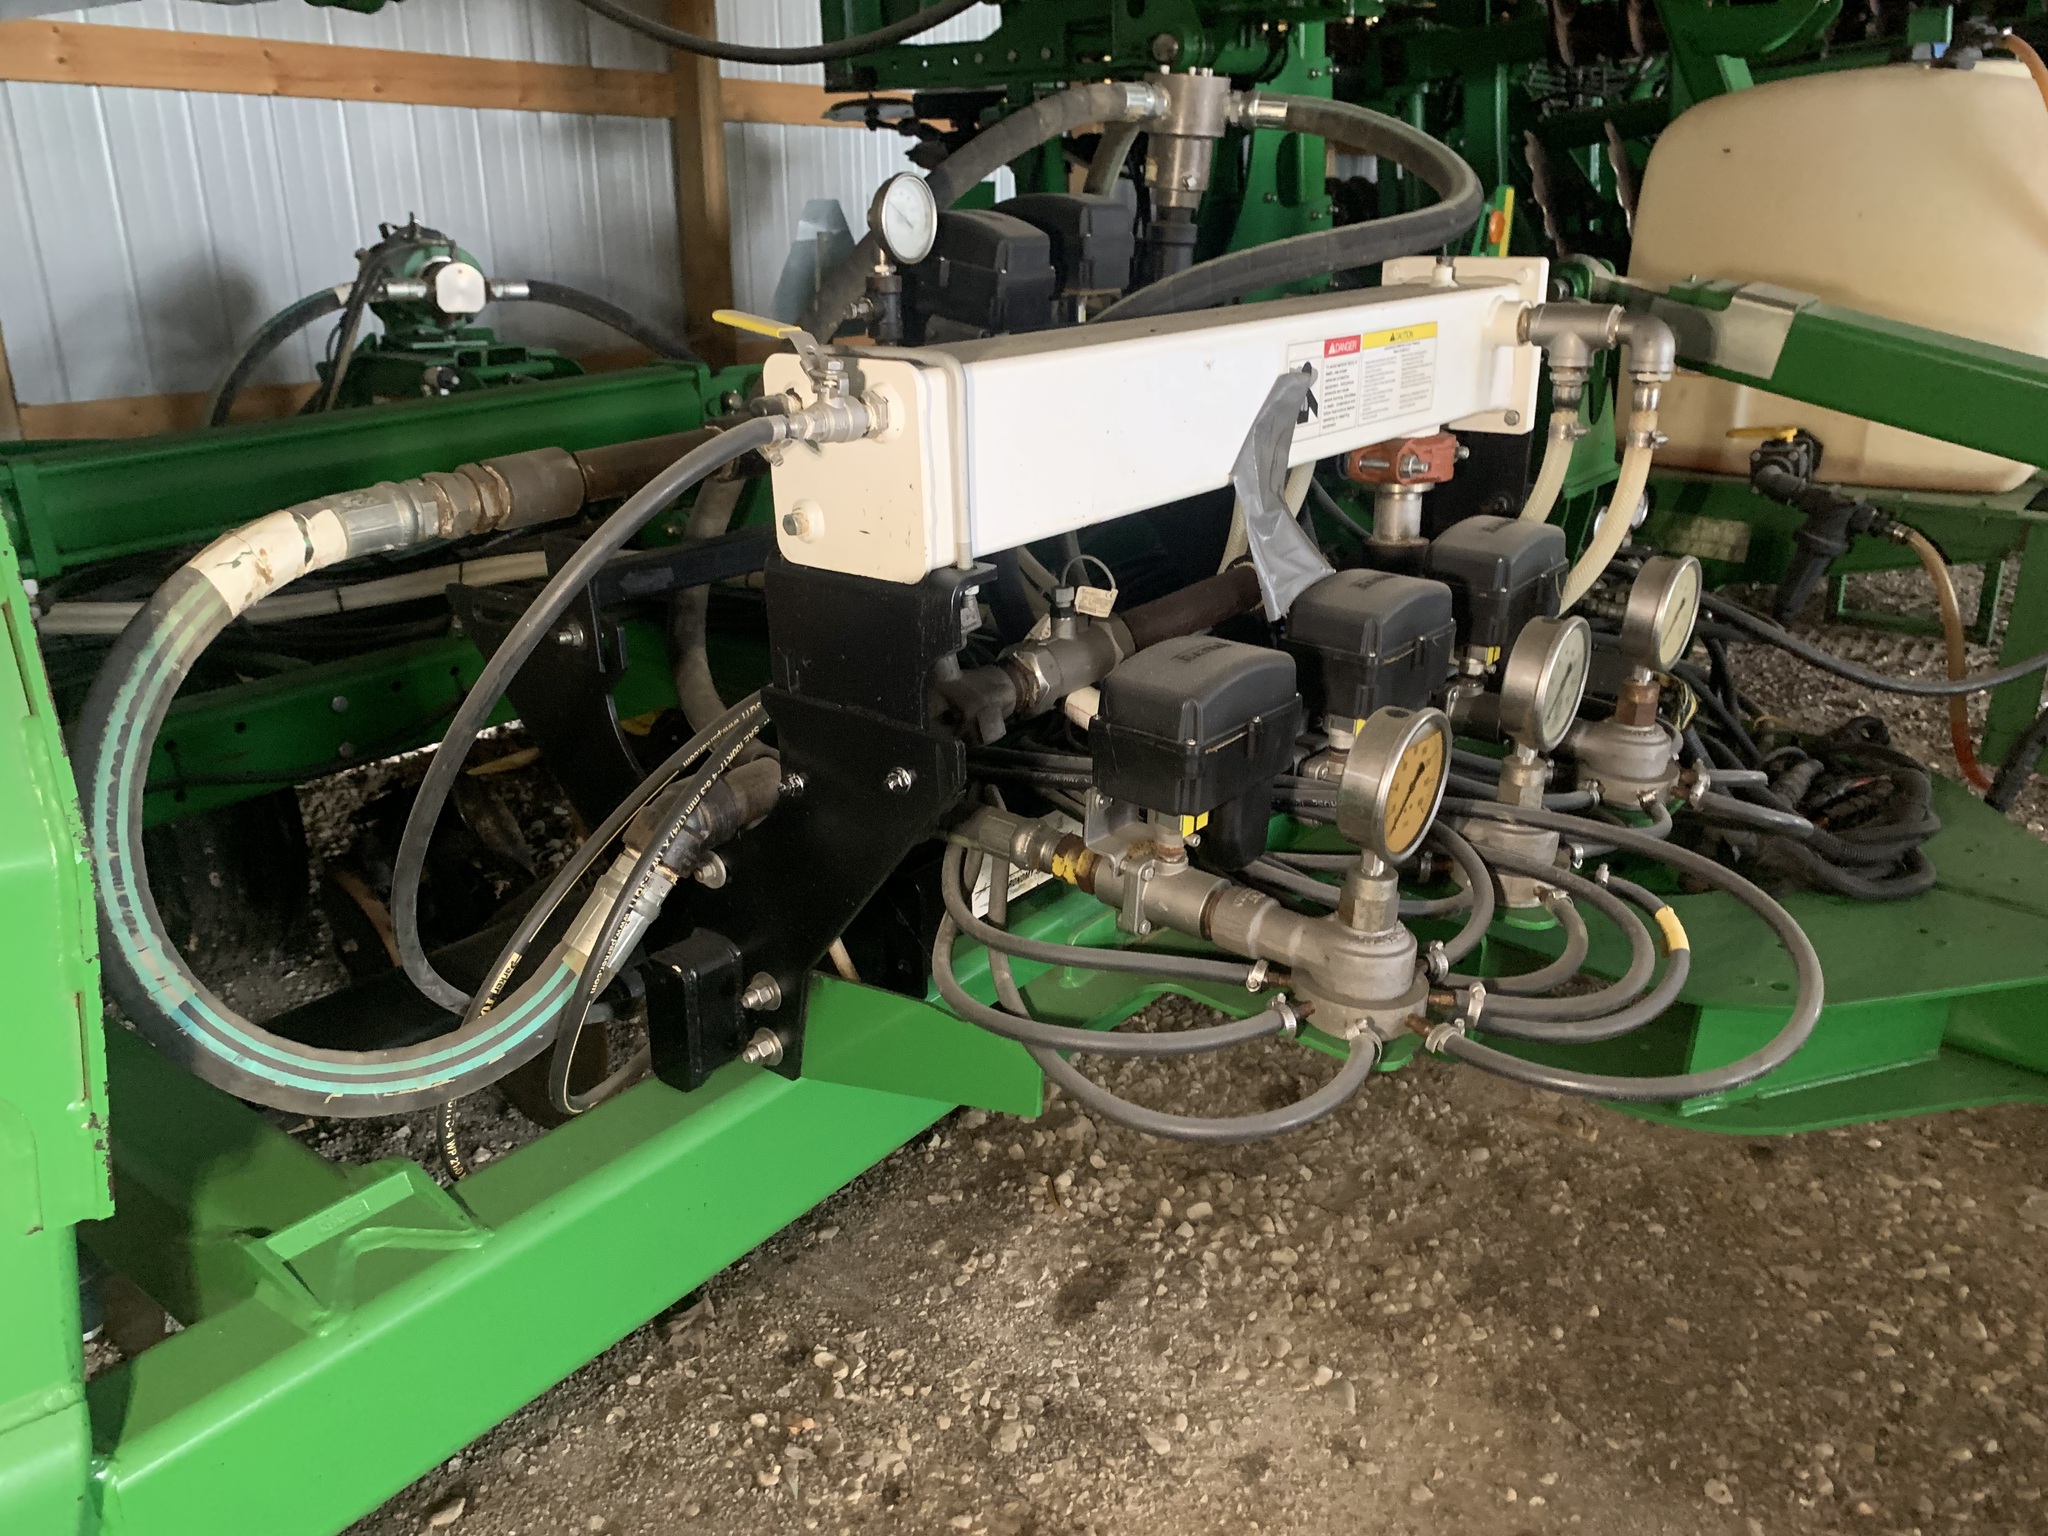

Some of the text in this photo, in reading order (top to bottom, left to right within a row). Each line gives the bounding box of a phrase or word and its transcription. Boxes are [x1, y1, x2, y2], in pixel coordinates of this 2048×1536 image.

[1335, 340, 1358, 353] DANGER
[744, 725, 760, 743] SAE
[590, 913, 631, 994] www.parker.com
[493, 955, 521, 992] Parker
[446, 1138, 458, 1156] WP
